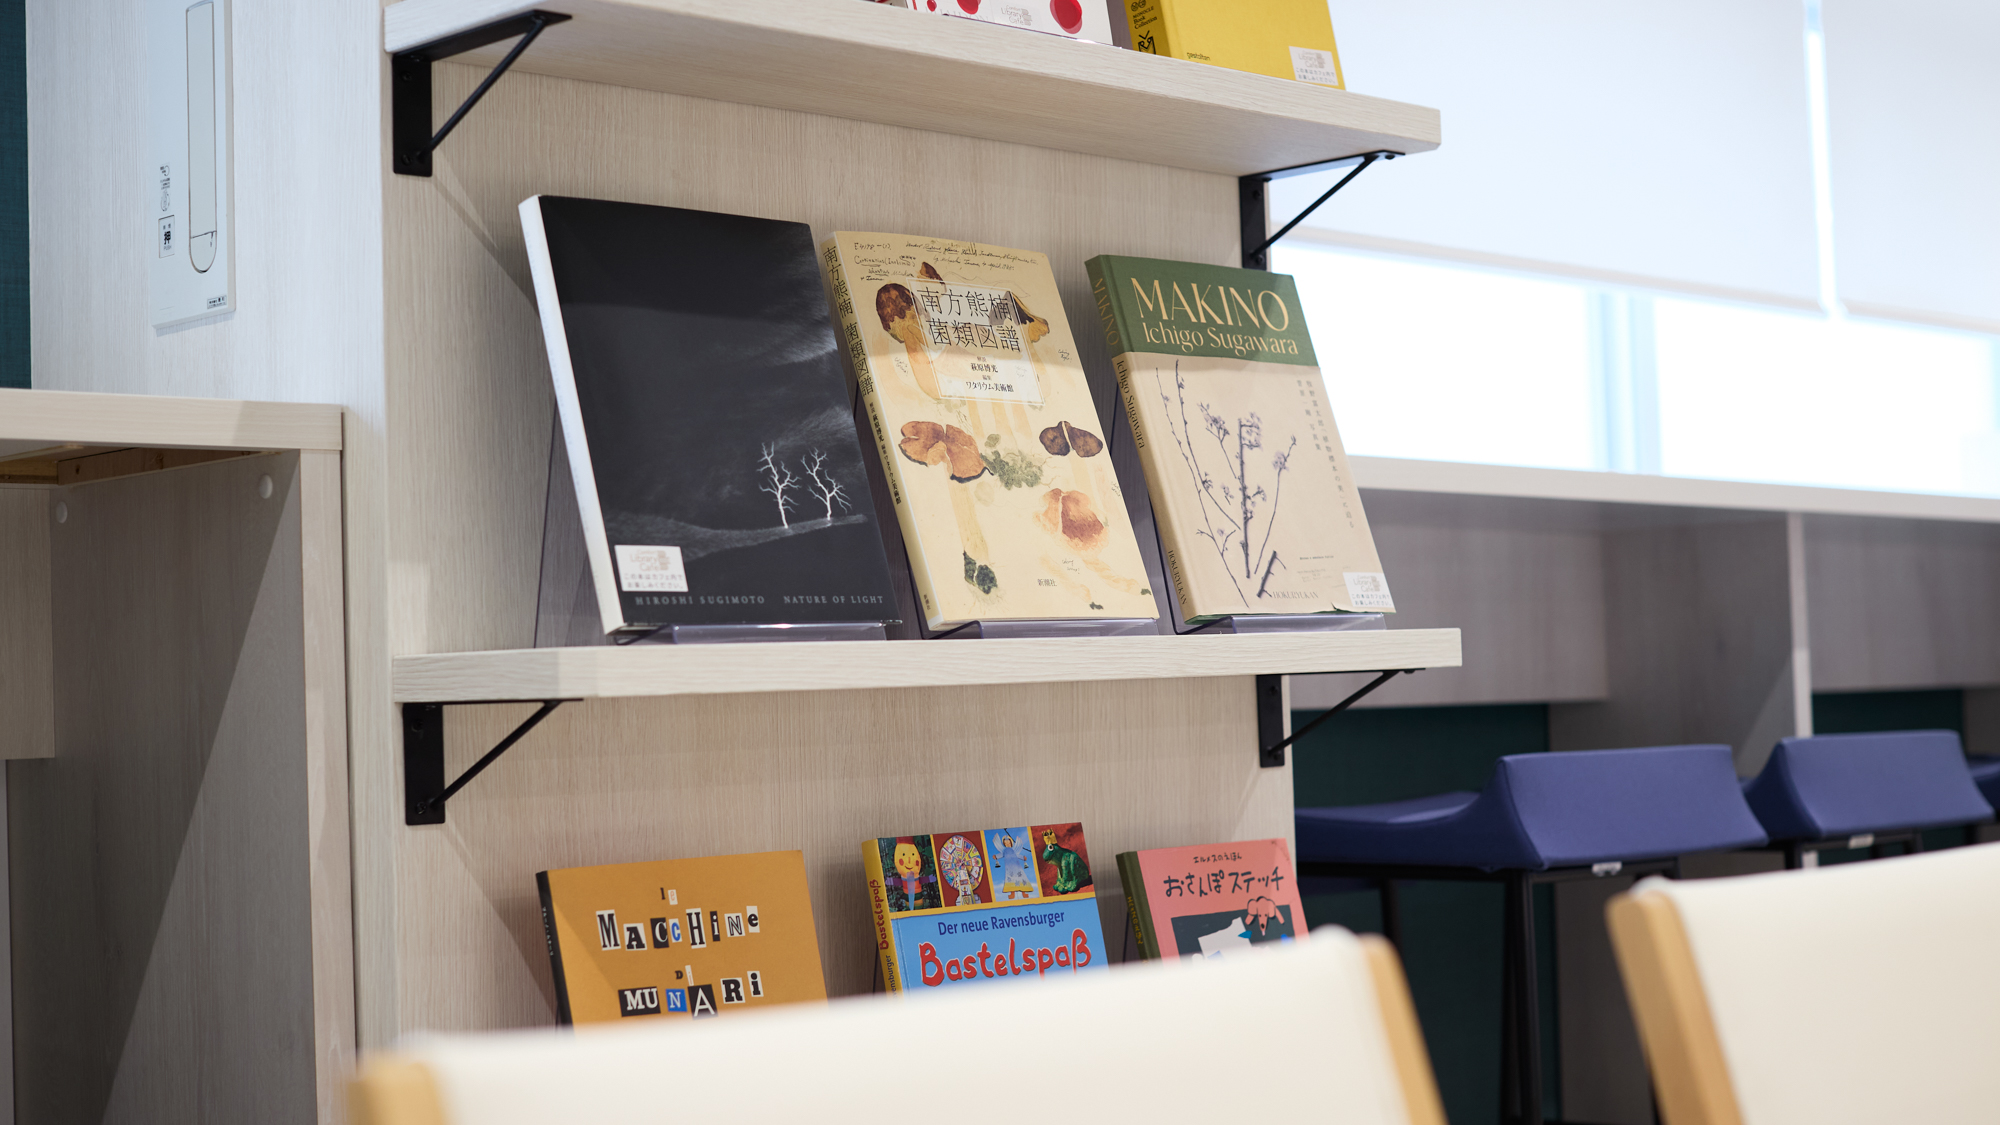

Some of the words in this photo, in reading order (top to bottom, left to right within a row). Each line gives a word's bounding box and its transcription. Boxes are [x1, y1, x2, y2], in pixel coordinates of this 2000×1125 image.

[916, 286, 1013, 321] 南方熊楠
[1094, 278, 1120, 346] MAKINO
[1130, 278, 1289, 332] MAKINO
[823, 246, 853, 318] 南方熊楠
[844, 322, 874, 397] 菌類図譜
[926, 319, 1021, 352] 菌類図譜
[1142, 322, 1204, 353] Ichigo
[1207, 327, 1298, 356] Sugawara
[966, 382, 1014, 392] ワタリウム美術館
[1116, 360, 1130, 394] Ichigo
[1126, 395, 1146, 449] Sugawara
[635, 596, 694, 606] HIROSHI
[700, 596, 765, 605] SUGIMOTO
[784, 596, 828, 604] NATURE
[832, 596, 846, 604] OF
[851, 595, 884, 604] LIGHT
[1193, 852, 1242, 864] エルメスのえほん
[1163, 866, 1284, 897] おさんぽステッチ
[938, 921, 958, 936] Der
[961, 920, 989, 933] neue
[990, 910, 1064, 930] Ravensburger
[918, 928, 1092, 987] Bastelspaß
